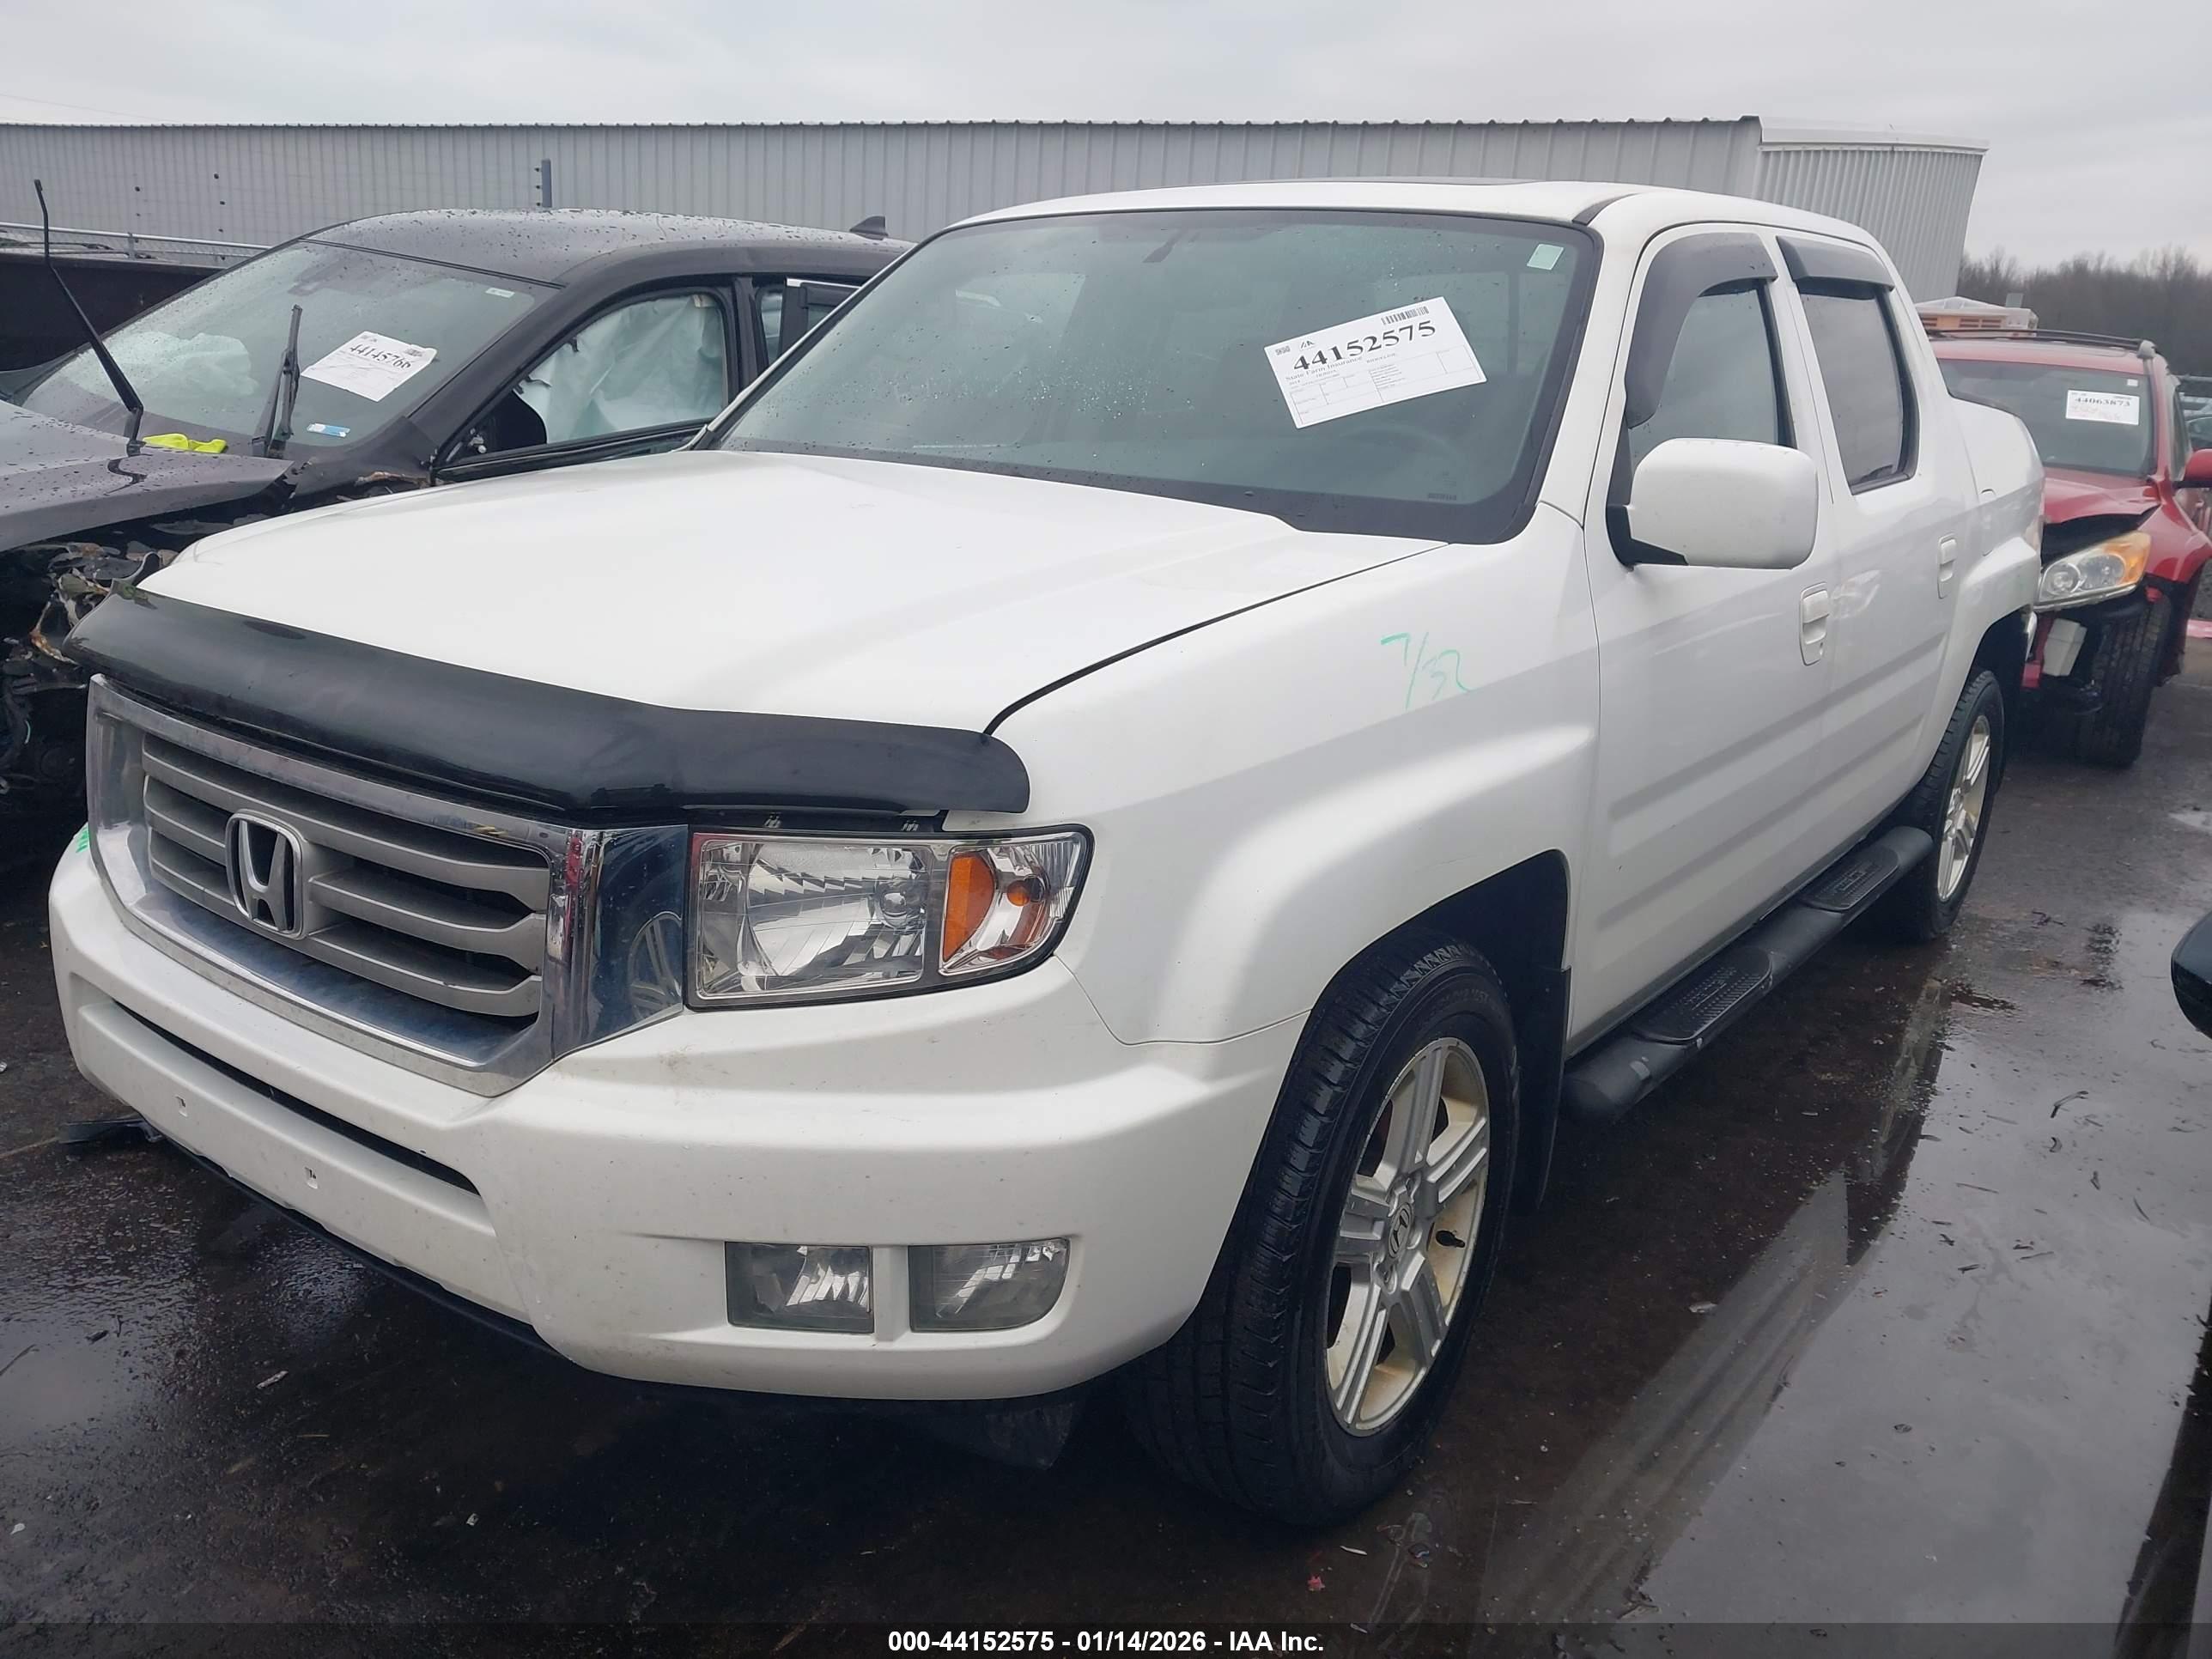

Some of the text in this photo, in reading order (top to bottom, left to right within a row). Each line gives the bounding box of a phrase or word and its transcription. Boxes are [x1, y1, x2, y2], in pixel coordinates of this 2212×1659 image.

[1293, 320, 1436, 371] 44152575
[1306, 367, 1326, 375] Farm
[1327, 357, 1363, 369] Insurance
